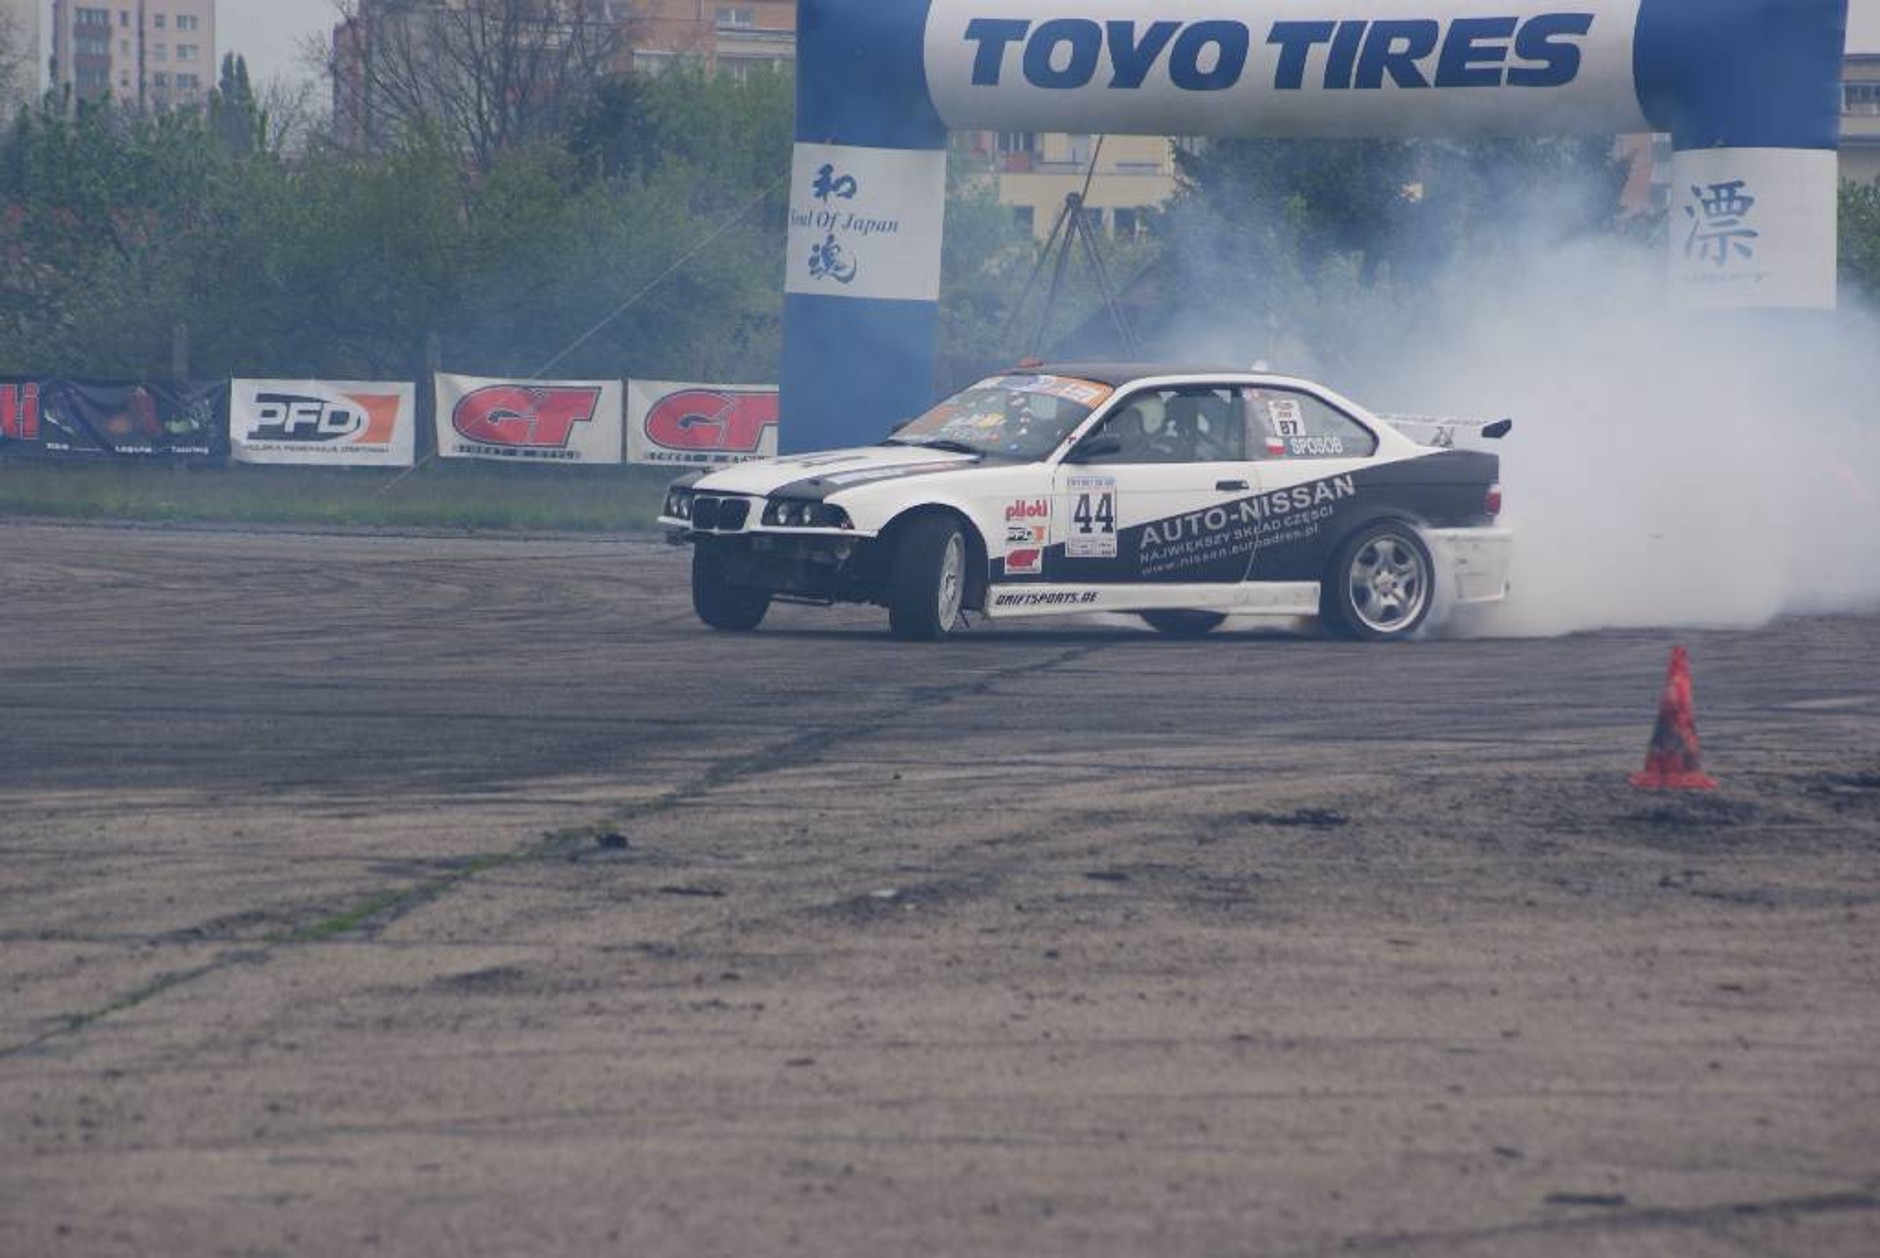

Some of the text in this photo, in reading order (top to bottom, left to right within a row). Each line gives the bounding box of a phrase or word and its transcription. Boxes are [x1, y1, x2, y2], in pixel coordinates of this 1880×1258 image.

[963, 13, 1594, 91] TOYO TIRES
[811, 163, 857, 202] 和
[841, 213, 899, 236] Japan
[248, 396, 363, 438] PFD
[452, 384, 601, 448] GT
[644, 389, 779, 452] GT
[1073, 493, 1114, 534] 44
[1139, 475, 1356, 549] AUTO-NISSAN
[996, 591, 1098, 606] DRIFTSPORTS.DE
